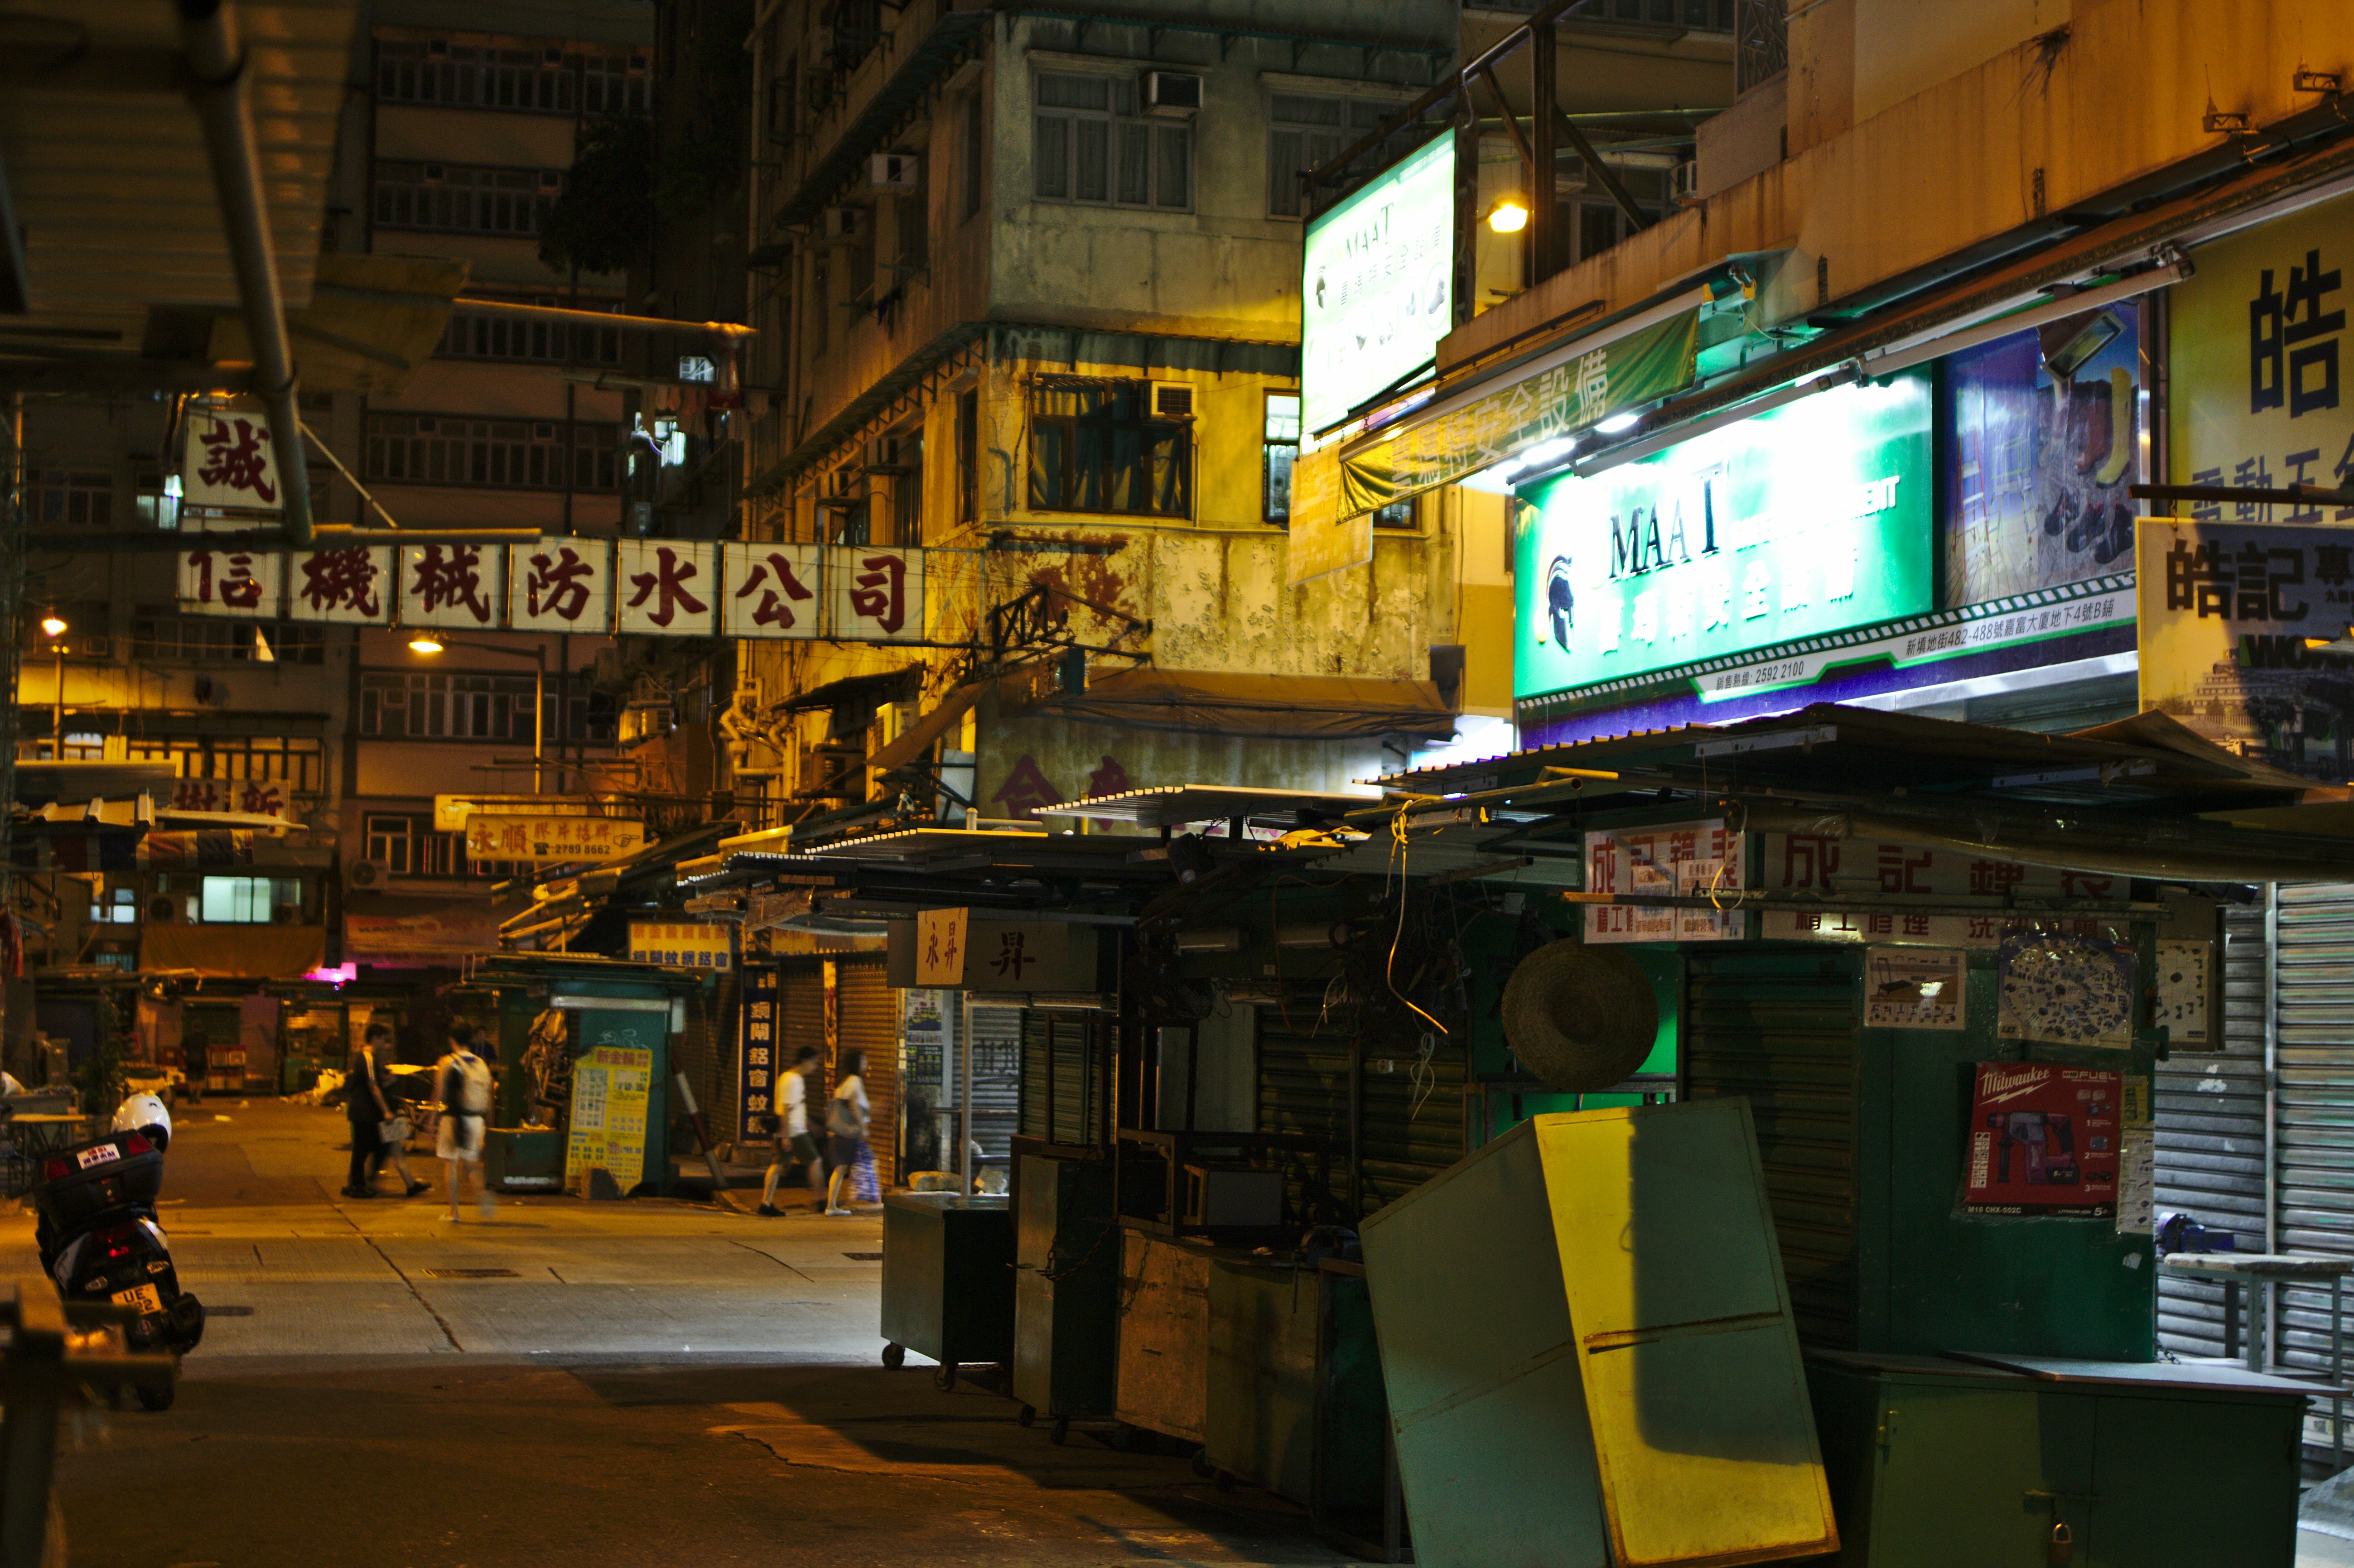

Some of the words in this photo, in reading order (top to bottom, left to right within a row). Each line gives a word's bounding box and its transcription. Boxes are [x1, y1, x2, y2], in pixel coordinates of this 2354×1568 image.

[1346, 202, 1394, 260] MAAT
[2250, 248, 2346, 419] 皓
[198, 418, 275, 502] 誠
[1608, 459, 1727, 582] MAAT
[188, 543, 906, 634] 信機械防水公司
[2166, 539, 2308, 621] 皓記
[1756, 665, 1778, 683] 2592
[1781, 660, 1804, 678] 2100
[473, 822, 527, 854] 永順
[584, 844, 610, 855] 8662
[926, 921, 957, 972] 永昇
[1980, 1066, 2051, 1097] Milwaukee
[2079, 1071, 2117, 1080] FUEL
[123, 1287, 146, 1303] UE
